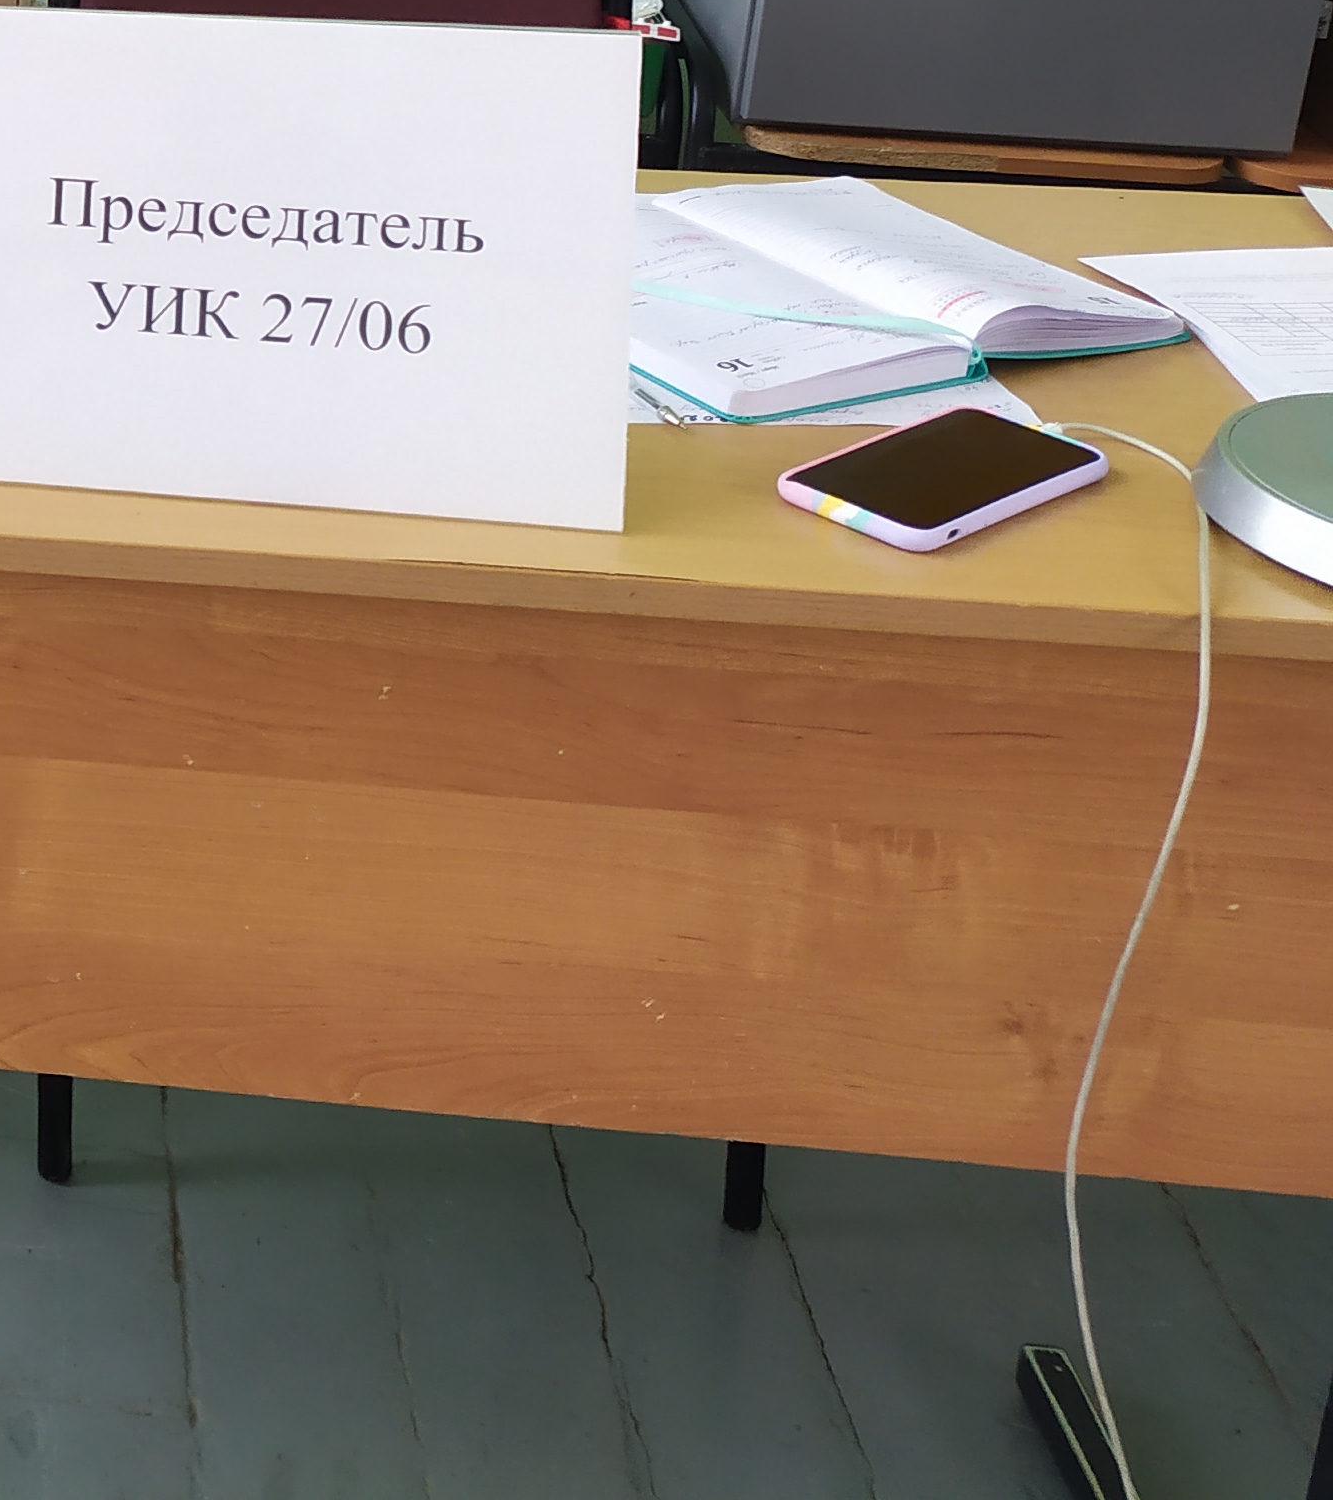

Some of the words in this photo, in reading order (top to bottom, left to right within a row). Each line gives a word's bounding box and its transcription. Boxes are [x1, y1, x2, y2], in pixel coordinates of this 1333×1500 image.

[47, 177, 486, 254] Председатель
[87, 280, 240, 341] УИК
[259, 291, 432, 354] 27/06
[717, 358, 754, 373] 16
